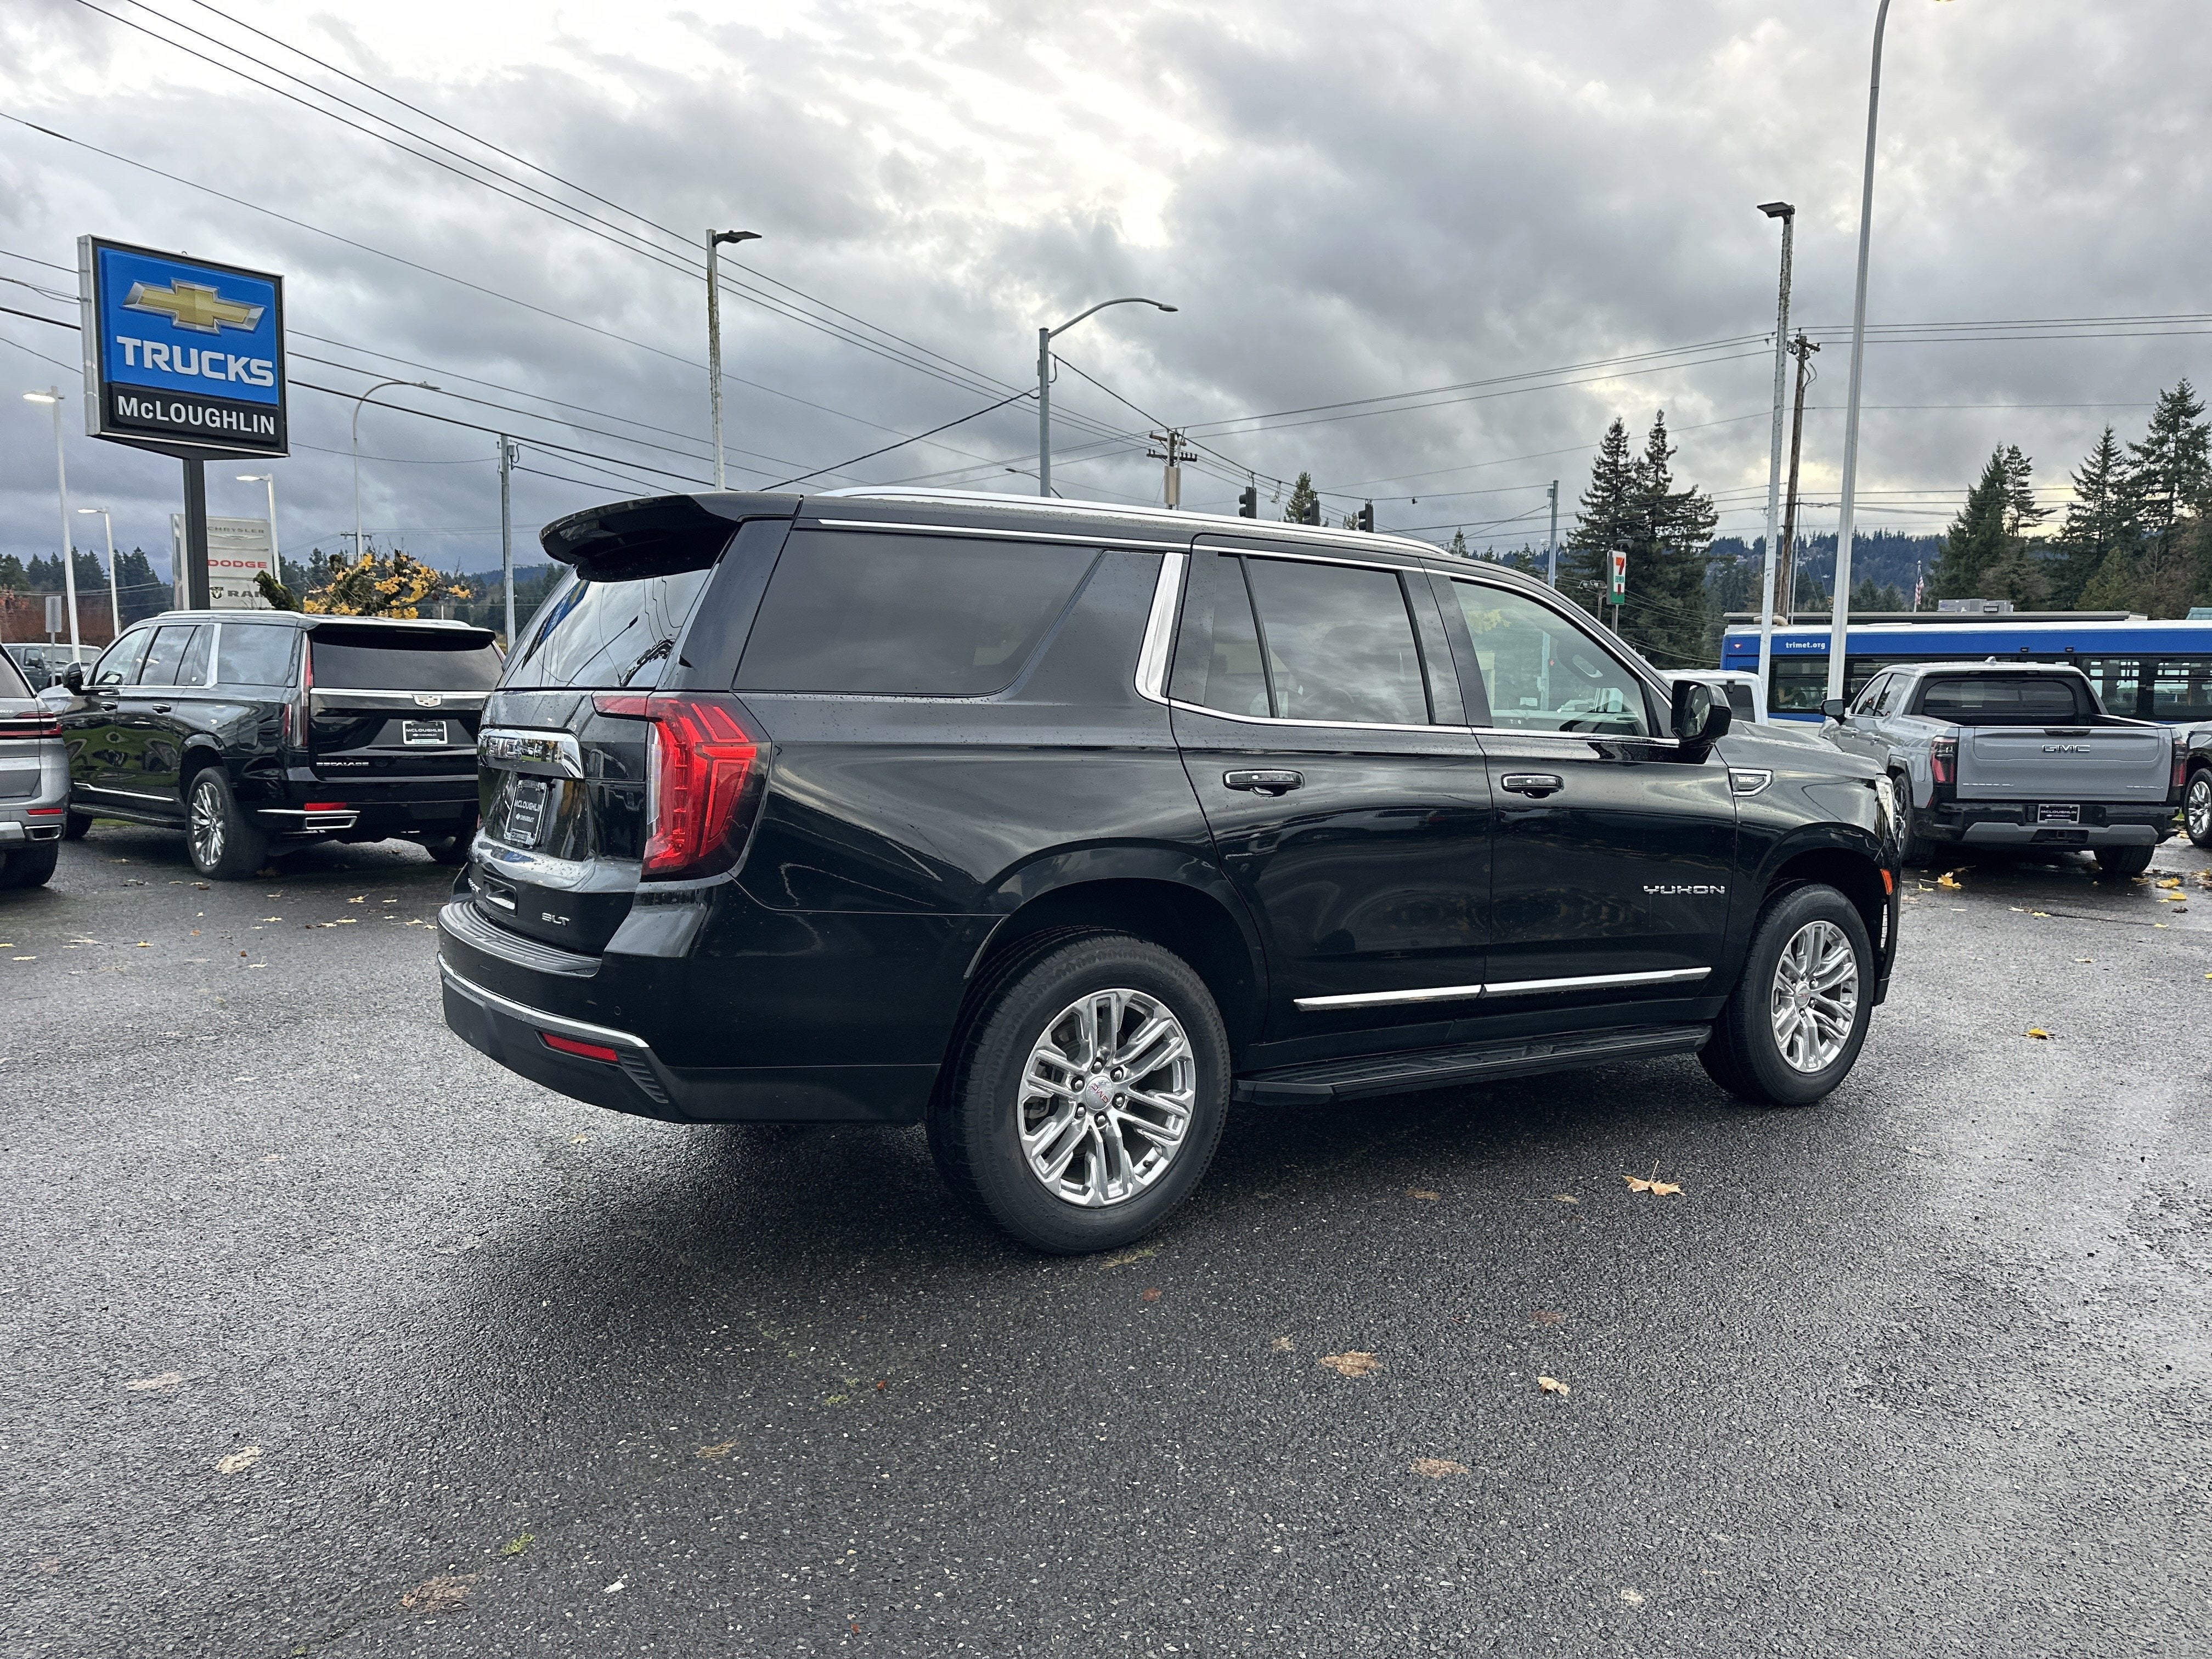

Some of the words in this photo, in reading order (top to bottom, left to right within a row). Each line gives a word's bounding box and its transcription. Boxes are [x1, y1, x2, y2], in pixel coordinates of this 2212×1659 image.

[116, 336, 274, 387] TRUCKS
[118, 396, 274, 435] McLOUGHLIN
[207, 559, 267, 568] DODGE
[1786, 641, 1826, 650] trimet.org
[2041, 744, 2090, 753] GMC
[1643, 885, 1725, 895] YUKON
[541, 912, 571, 926] SLT
[1091, 1082, 1109, 1104] GMC
